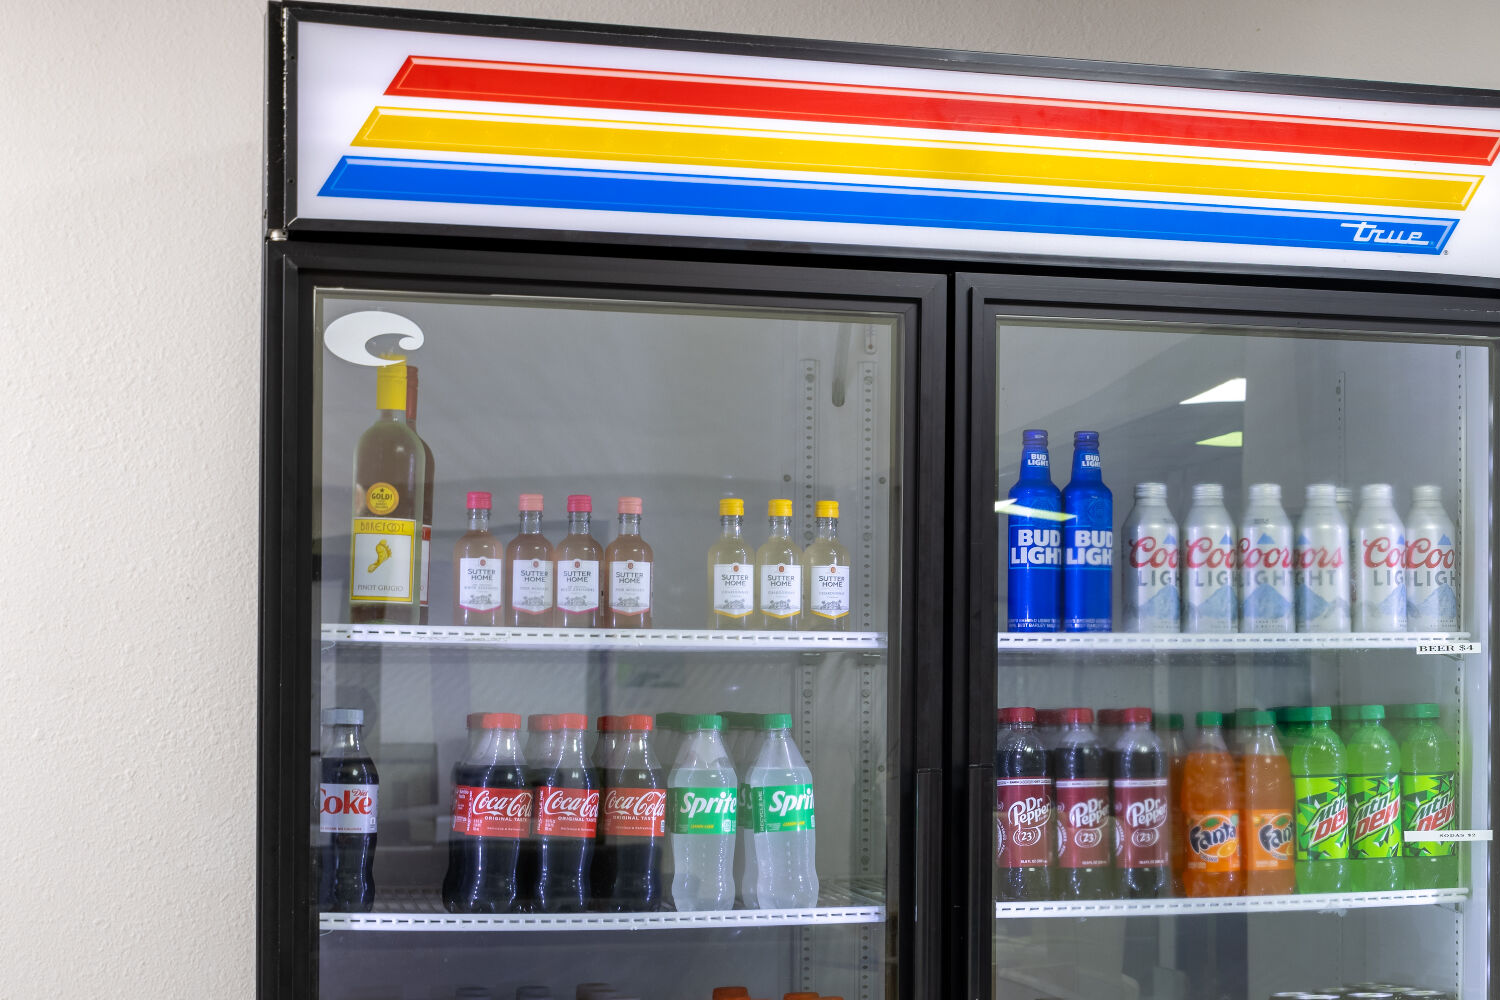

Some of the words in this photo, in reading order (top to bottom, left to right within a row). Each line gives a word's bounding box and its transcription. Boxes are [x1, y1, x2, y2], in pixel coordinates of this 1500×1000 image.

[1340, 221, 1430, 246] true
[1027, 459, 1049, 467] LIGHT
[371, 492, 393, 500] GOLD!
[1017, 529, 1061, 547] BUD
[1074, 530, 1112, 547] BUD
[467, 568, 496, 576] SUTTER
[520, 569, 549, 577] SUTTER
[524, 575, 546, 583] HOME
[357, 584, 376, 592] PINOT
[1418, 644, 1455, 652] BEER
[1458, 643, 1474, 652] $4
[605, 790, 667, 818] Coca-Cola
[680, 791, 738, 818] Sprite
[1025, 796, 1044, 811] Dr
[1087, 797, 1104, 811] Dr
[1145, 797, 1162, 811] Dr
[1009, 801, 1051, 827] Pepper
[1020, 831, 1034, 841] 23
[1083, 832, 1096, 842] 23
[1140, 831, 1153, 841] 23
[1190, 824, 1237, 851] Fanta
